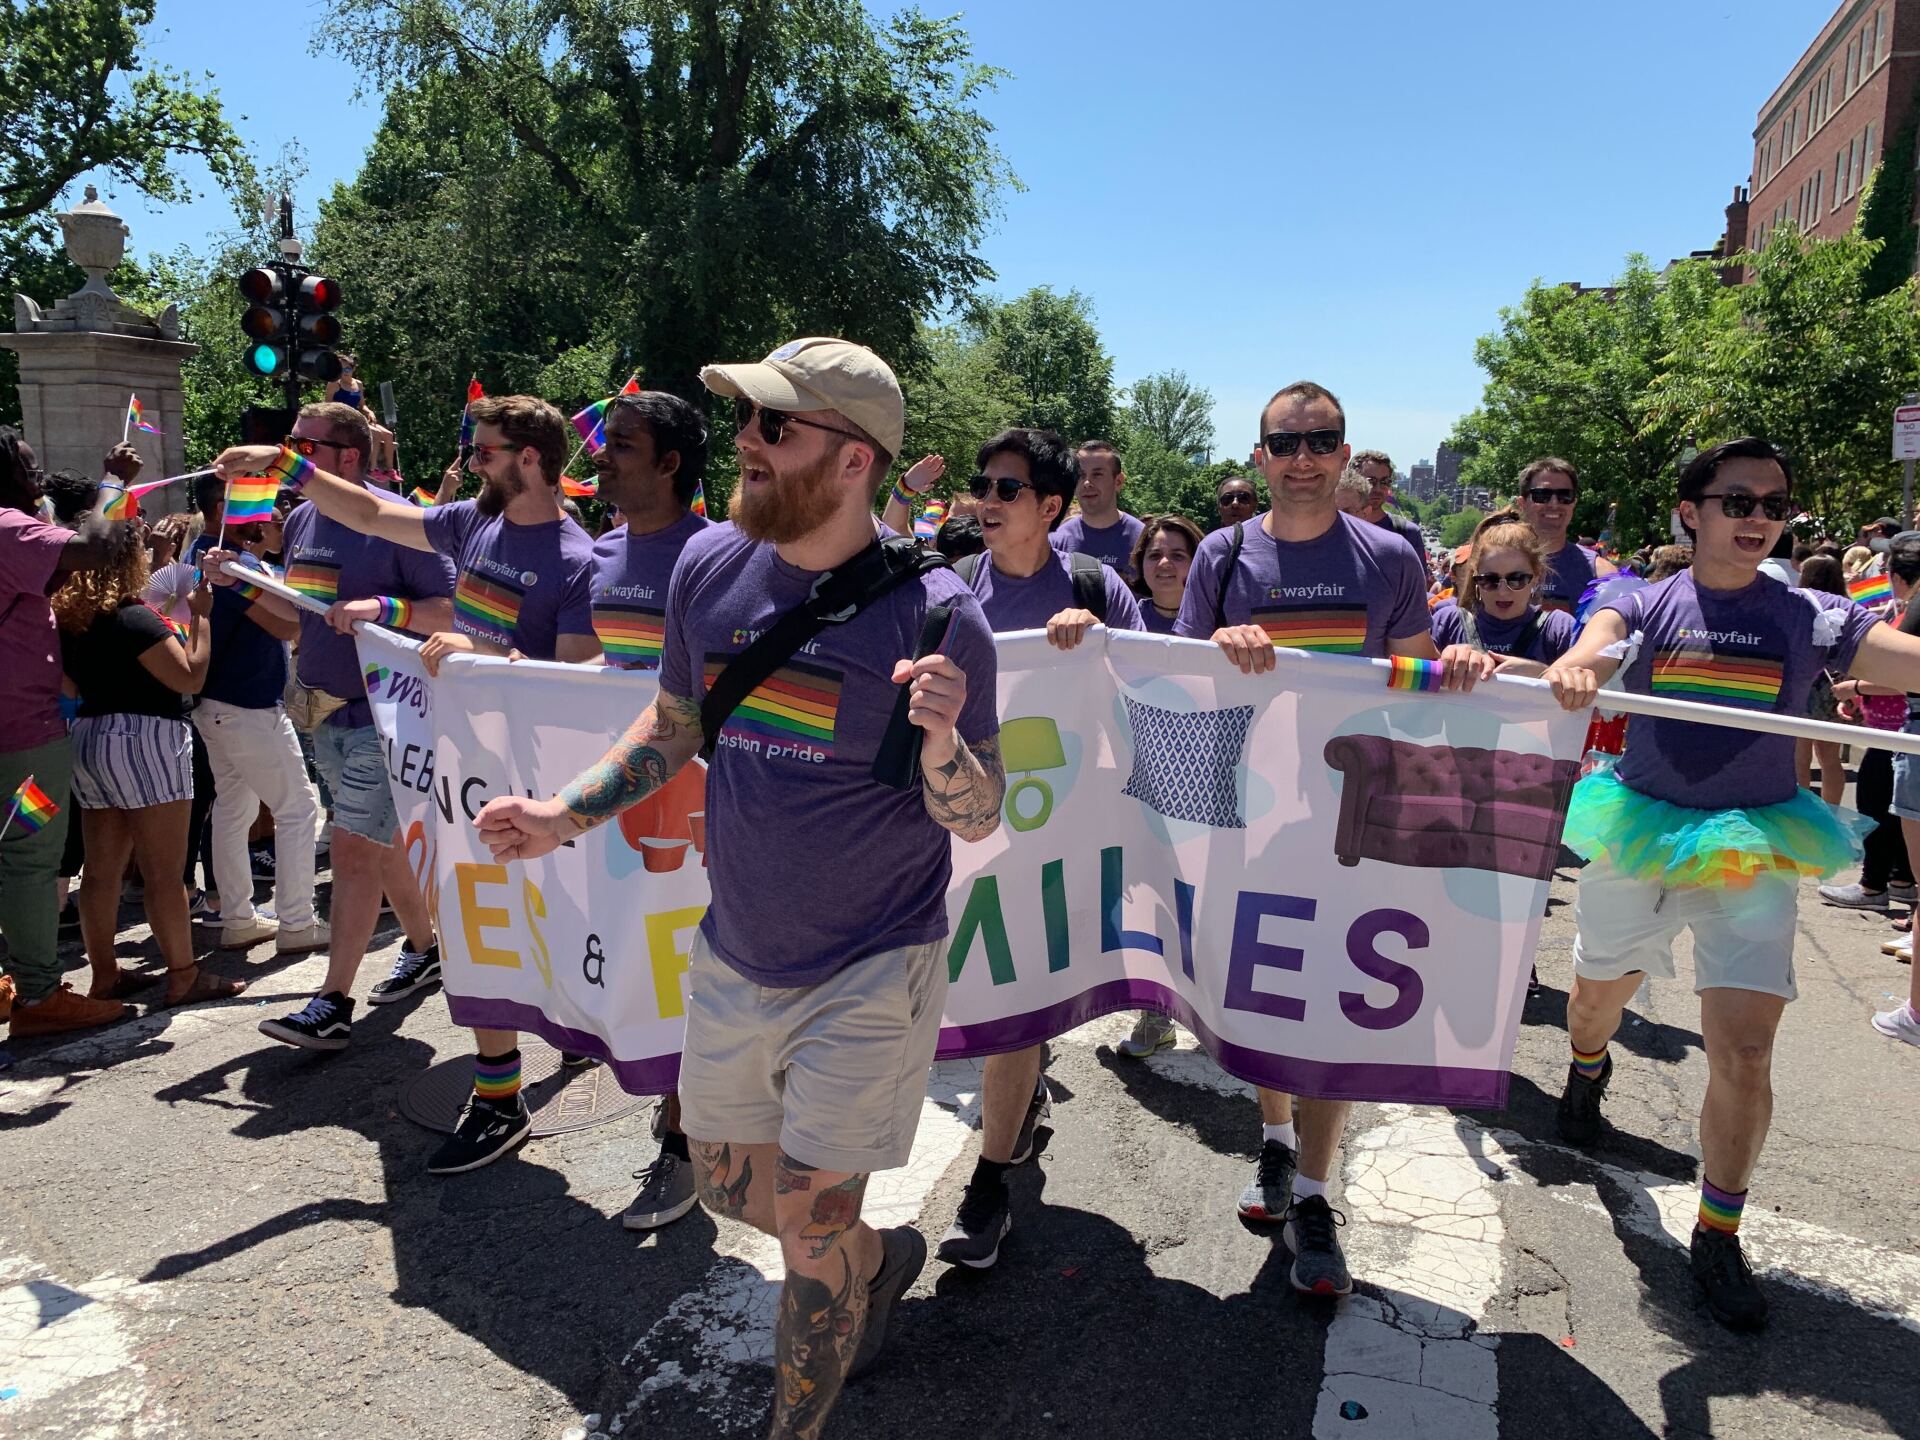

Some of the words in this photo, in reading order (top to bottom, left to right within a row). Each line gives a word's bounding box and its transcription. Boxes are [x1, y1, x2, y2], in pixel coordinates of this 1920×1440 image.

[484, 558, 519, 578] wayfair
[611, 584, 655, 600] wayfair
[1283, 583, 1345, 599] wayfair
[1692, 629, 1762, 645] wayfair
[766, 742, 826, 764] pride
[582, 933, 605, 989] &
